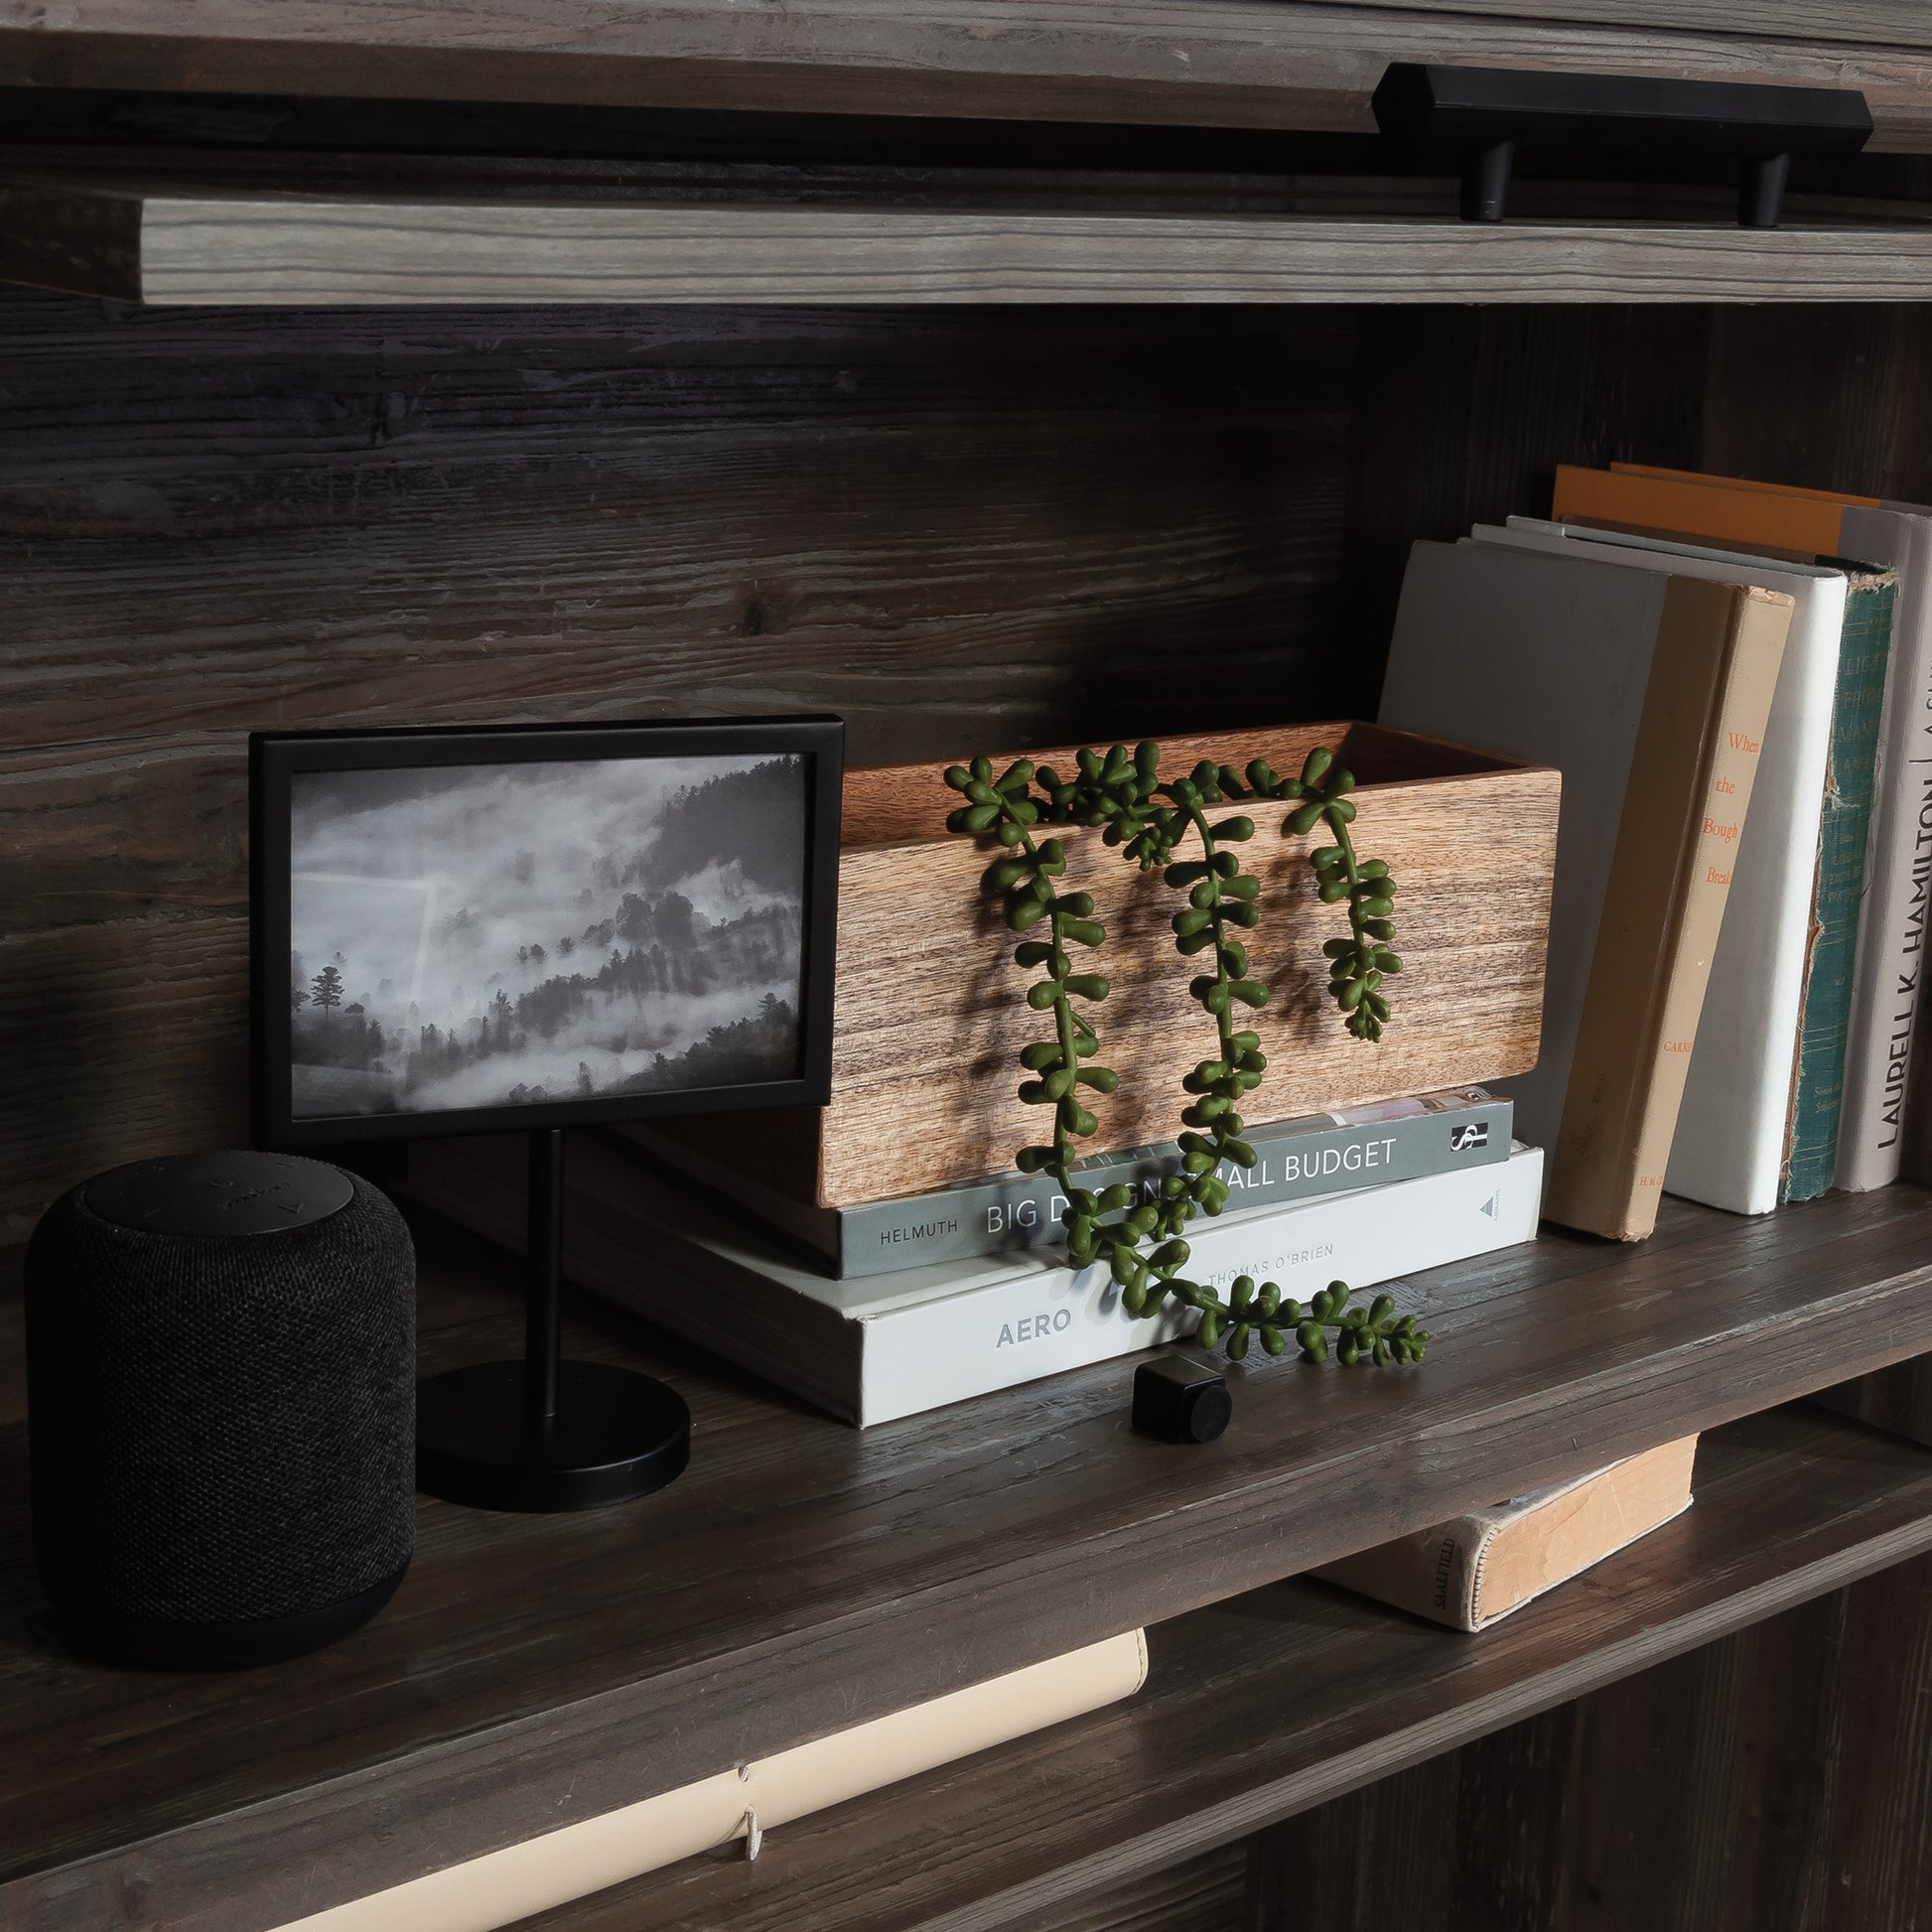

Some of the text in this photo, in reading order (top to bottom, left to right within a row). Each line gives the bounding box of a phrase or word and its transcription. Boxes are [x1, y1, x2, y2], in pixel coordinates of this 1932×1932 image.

[1728, 732, 1759, 754] When
[1716, 776, 1735, 794] the
[1703, 817, 1738, 843] Bough
[1877, 1000, 1915, 1150] LAURELL
[1897, 960, 1919, 994] K.
[987, 1138, 1398, 1233] BIG DGN ALL BUDGET
[880, 1219, 958, 1245] HELMUTH
[1208, 1244, 1333, 1286] THOMAS O'BRIEN
[996, 1309, 1071, 1348] AERO
[1435, 1538, 1455, 1609] SAALFIELD
